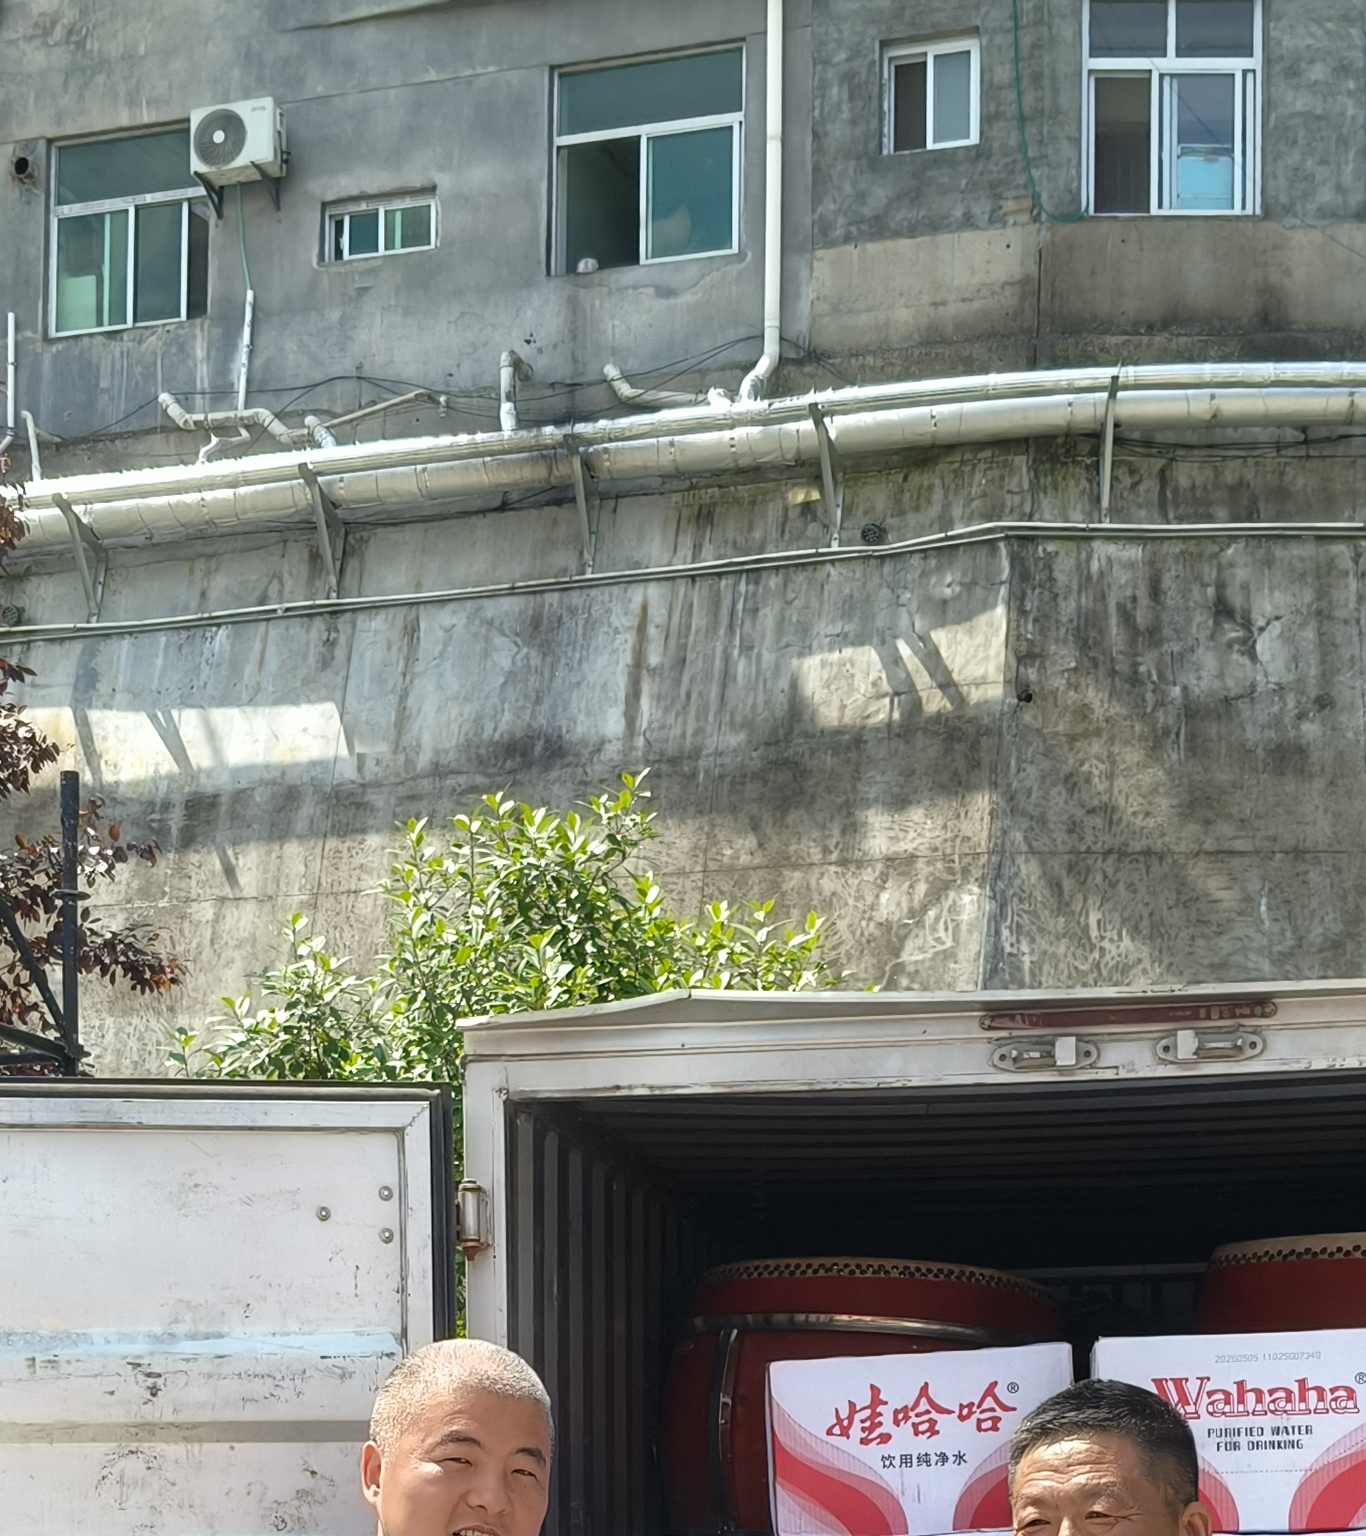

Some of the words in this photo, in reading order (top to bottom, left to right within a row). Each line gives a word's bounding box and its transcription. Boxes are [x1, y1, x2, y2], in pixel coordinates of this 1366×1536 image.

[1151, 1376, 1360, 1419] Wahaha
[826, 1381, 1017, 1446] 娃哈哈
[1207, 1426, 1264, 1438] PURIFIED
[1270, 1425, 1313, 1436] WATER
[1216, 1441, 1242, 1452] FOR
[1247, 1439, 1304, 1451] DRINKING
[881, 1450, 968, 1469] 饮用纯净水
